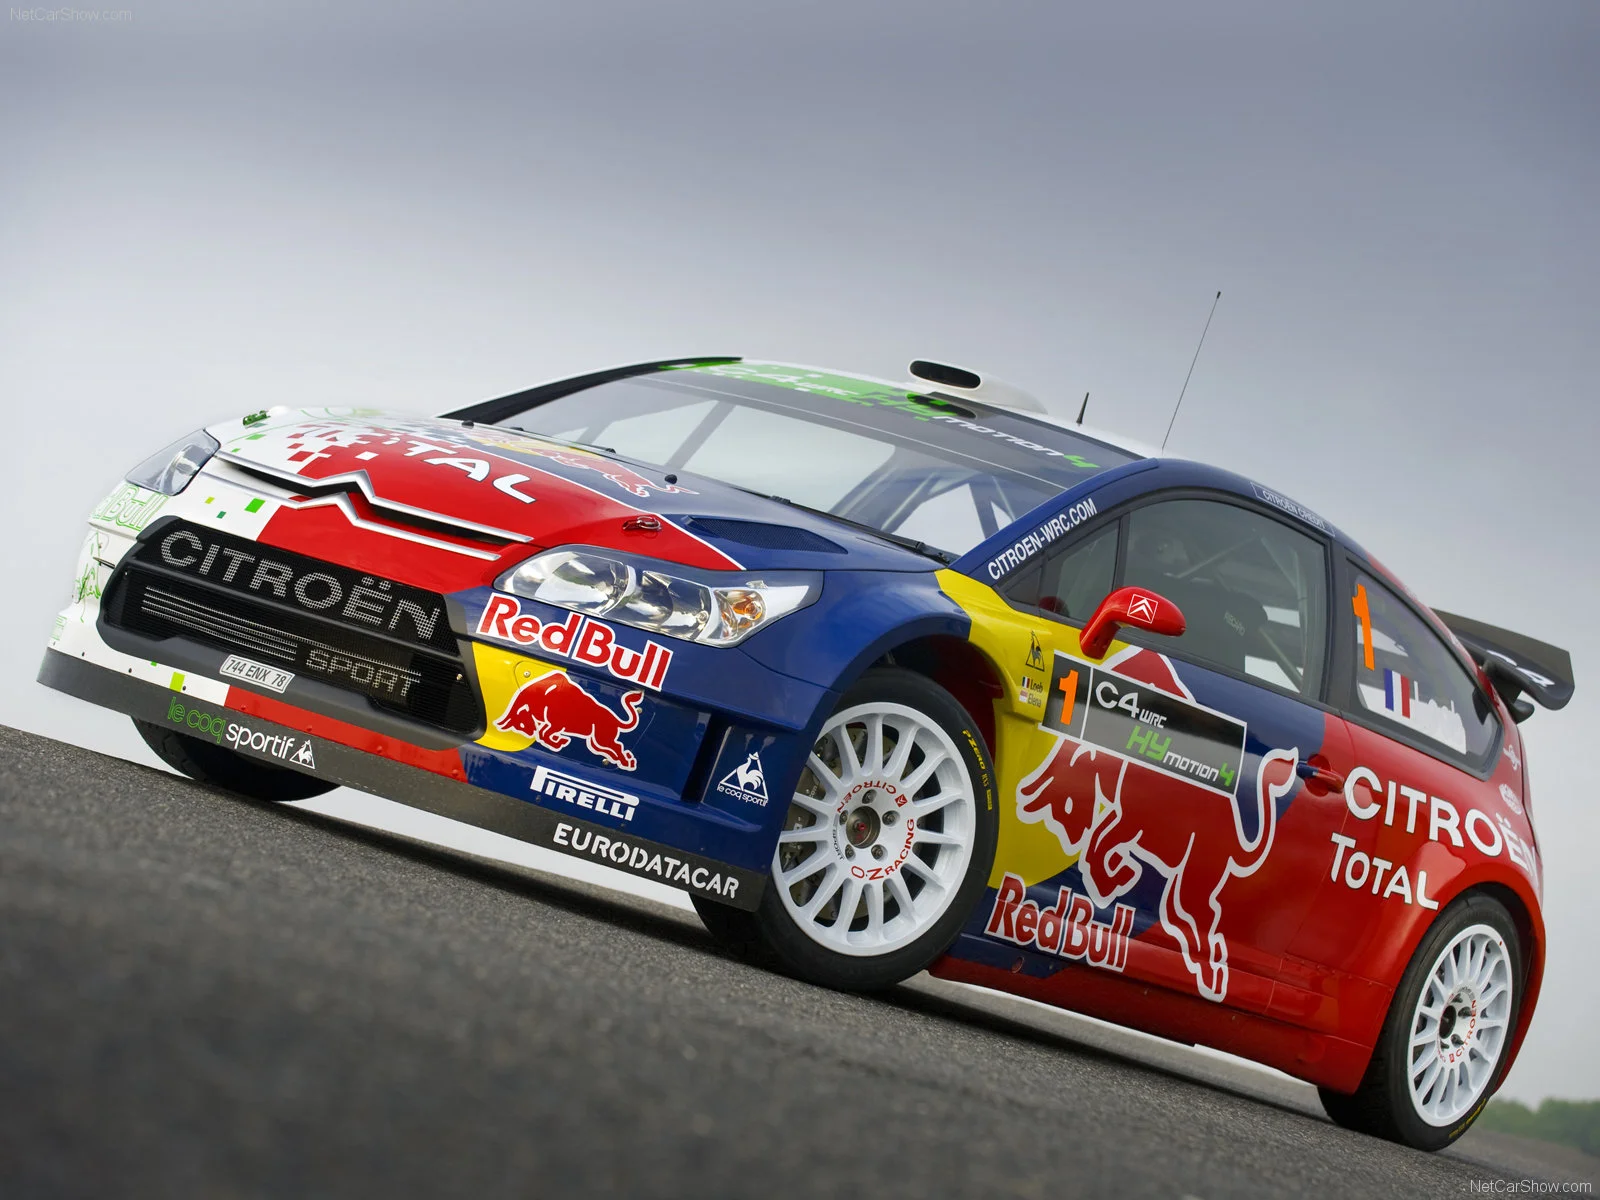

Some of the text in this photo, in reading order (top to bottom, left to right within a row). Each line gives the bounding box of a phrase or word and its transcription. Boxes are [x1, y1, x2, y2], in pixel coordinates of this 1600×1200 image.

[987, 498, 1098, 580] CITROEN-WRC.COM
[161, 530, 440, 640] CITROËN
[1352, 583, 1375, 671] 1
[224, 659, 287, 688] 744 ENX 78
[306, 649, 422, 697] SPORT
[1058, 670, 1079, 726] 1
[1095, 681, 1140, 719] C4
[167, 696, 296, 760] le coq sportif
[529, 765, 640, 822] PIRELLI
[716, 783, 769, 807] le coq sportif
[884, 818, 915, 876] RACING
[1343, 765, 1540, 890] CITROËN
[552, 822, 740, 899] EURODATACAR
[1330, 832, 1440, 911] TOTAL
